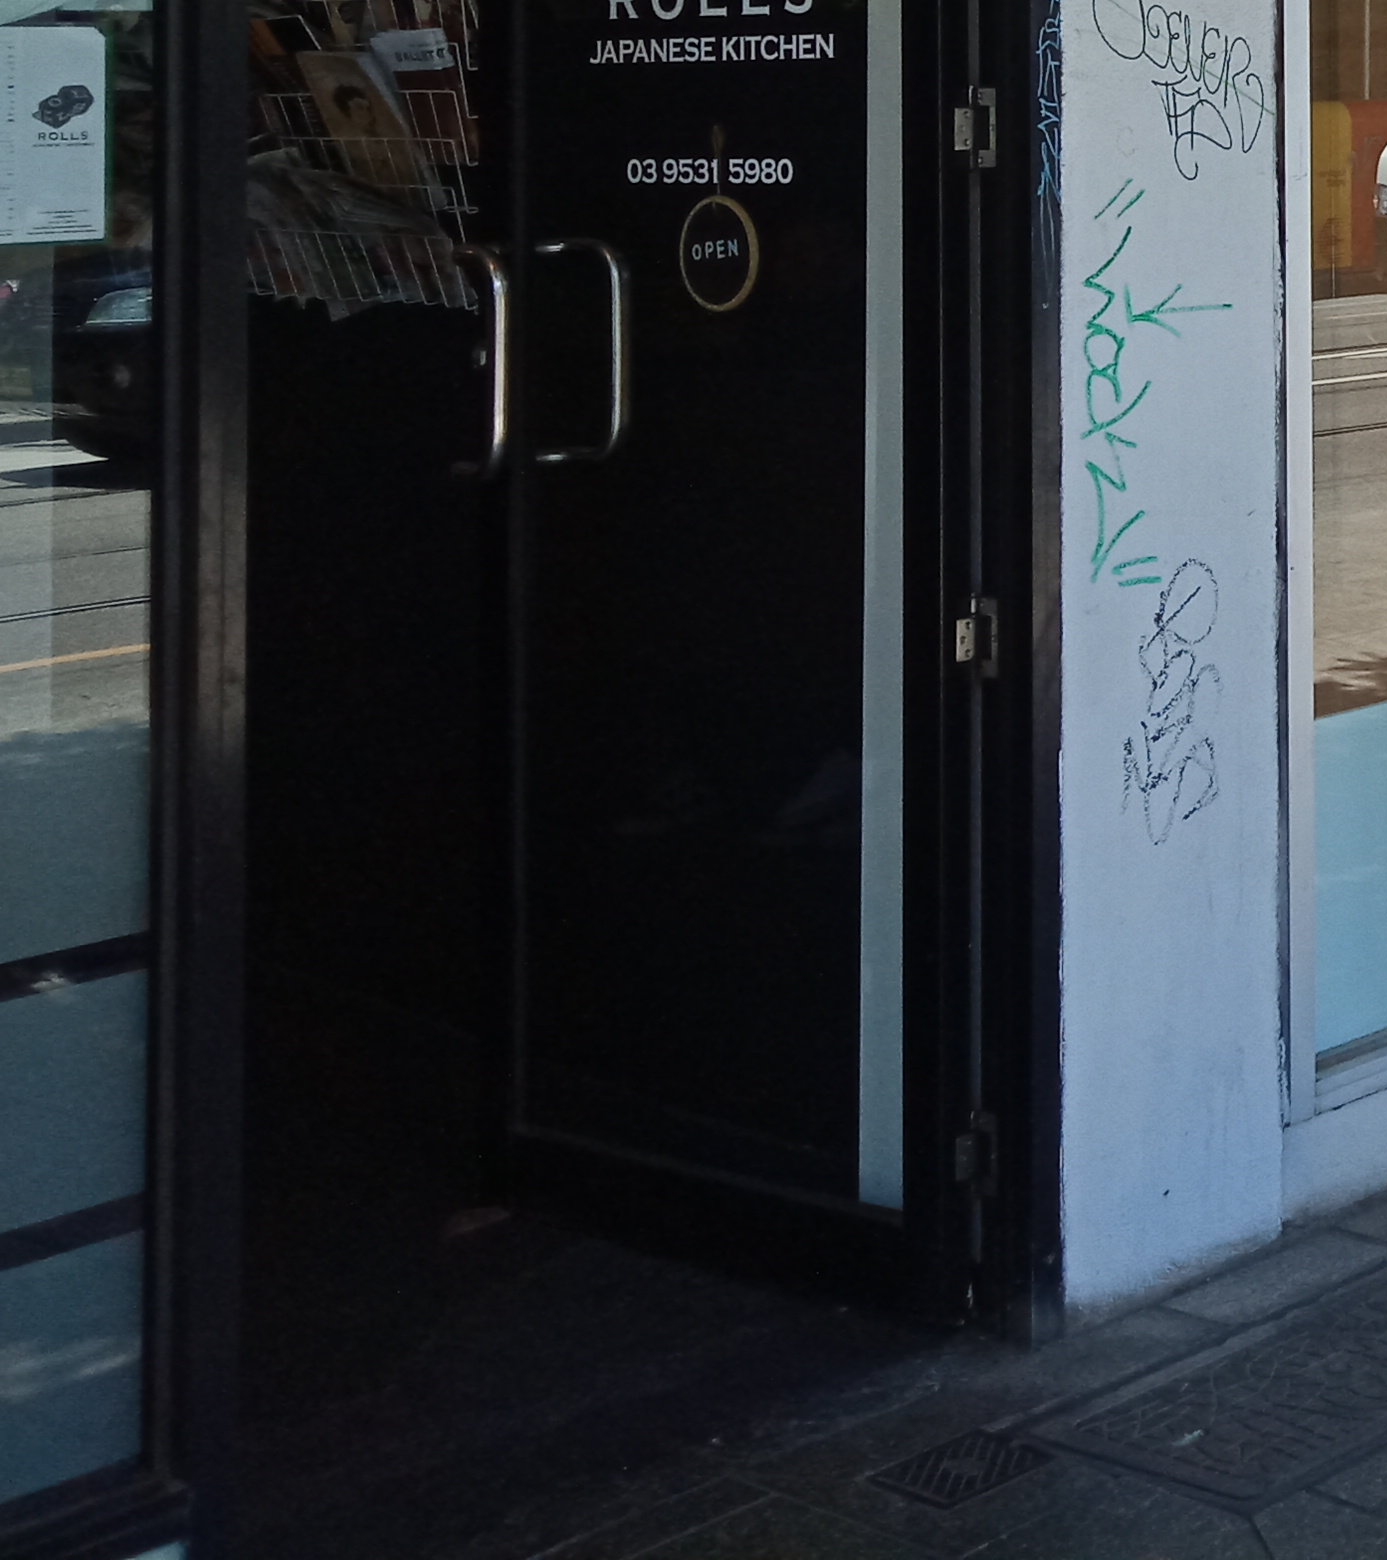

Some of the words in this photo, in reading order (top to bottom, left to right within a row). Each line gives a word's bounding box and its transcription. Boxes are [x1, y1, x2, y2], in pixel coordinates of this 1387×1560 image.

[589, 37, 716, 64] JAPANESE
[722, 33, 835, 60] KITCHEN
[37, 131, 89, 142] ROLLS
[626, 159, 657, 184] 03
[662, 158, 720, 184] 9531
[728, 158, 793, 183] 5980
[691, 239, 739, 261] OPEN
